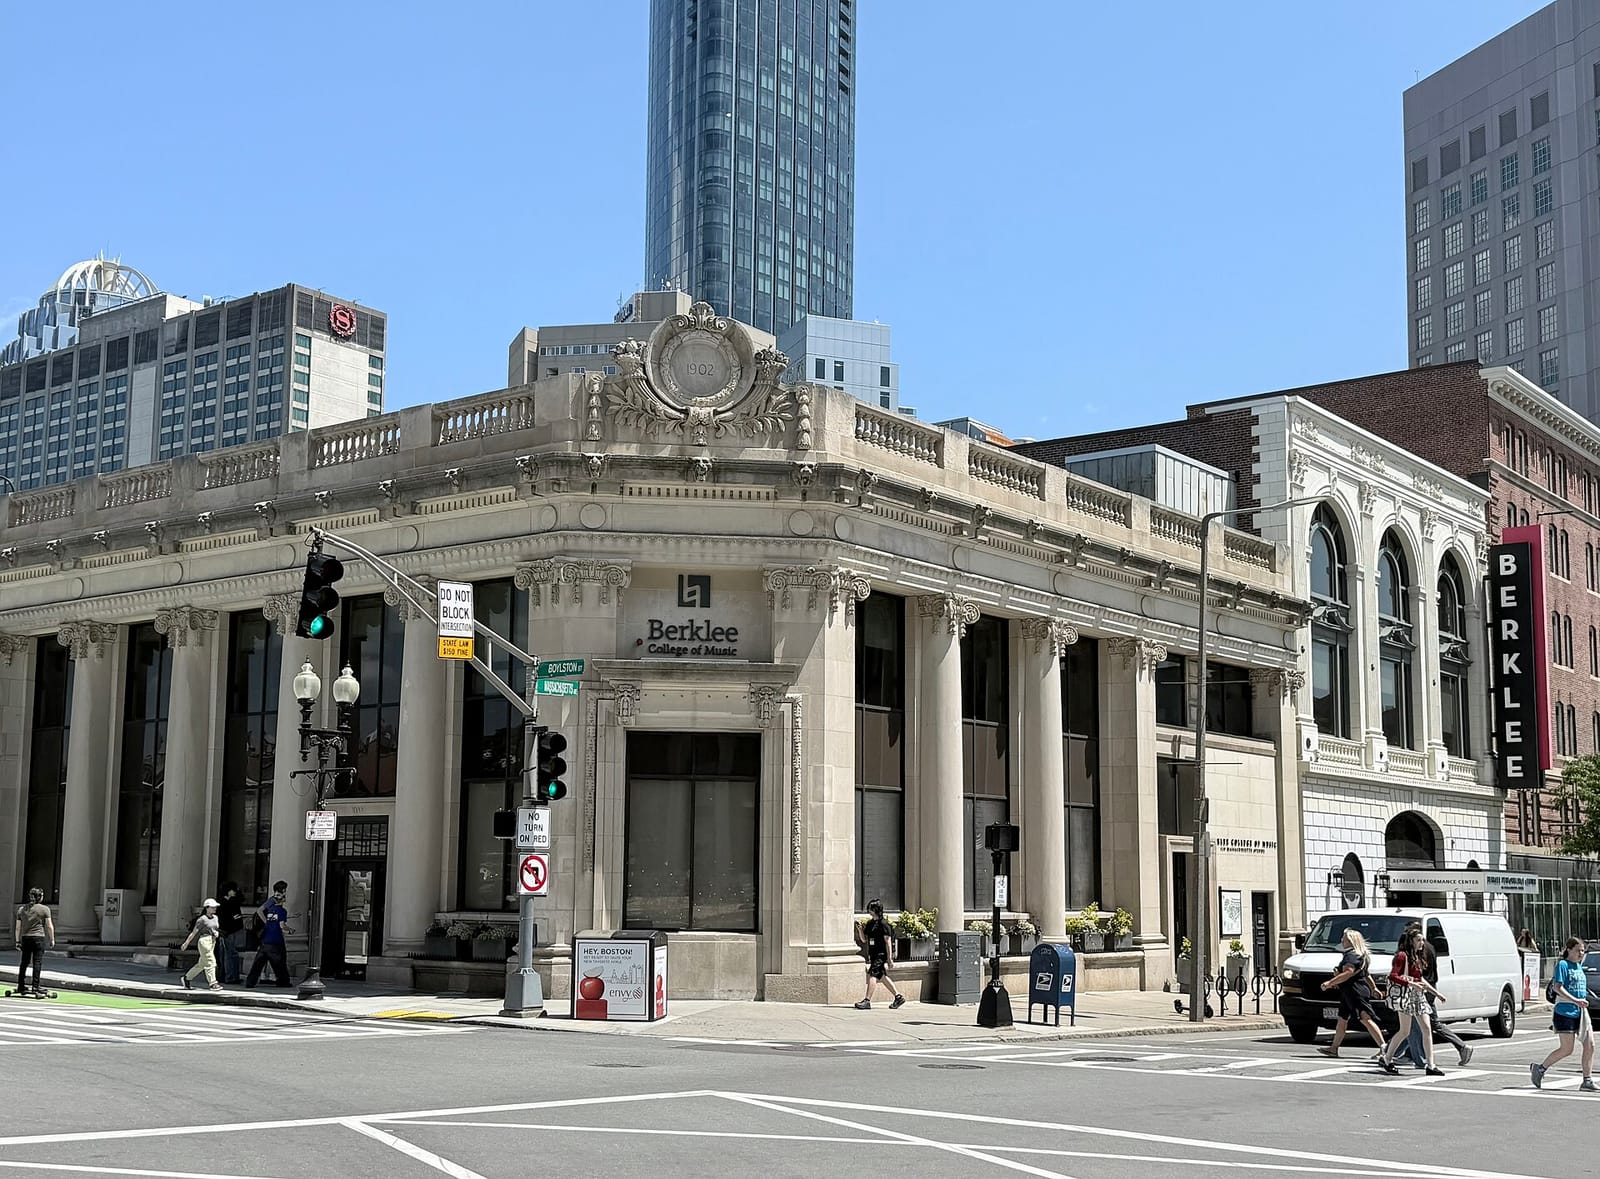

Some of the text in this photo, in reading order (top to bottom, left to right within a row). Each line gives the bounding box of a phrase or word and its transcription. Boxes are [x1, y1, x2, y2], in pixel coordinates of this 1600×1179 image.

[687, 362, 714, 377] 1902
[440, 588, 470, 602] DO NOT
[442, 606, 470, 620] BLOCK
[440, 622, 472, 631] INTERSECTION
[647, 619, 739, 642] Berklee
[648, 643, 738, 656] College of Music
[548, 662, 577, 673] BOYLSTON
[1499, 554, 1524, 778] BERKLEE
[528, 813, 540, 821] NO
[524, 823, 543, 832] TURN
[519, 834, 547, 843] ON RED
[609, 989, 632, 1002] envy
